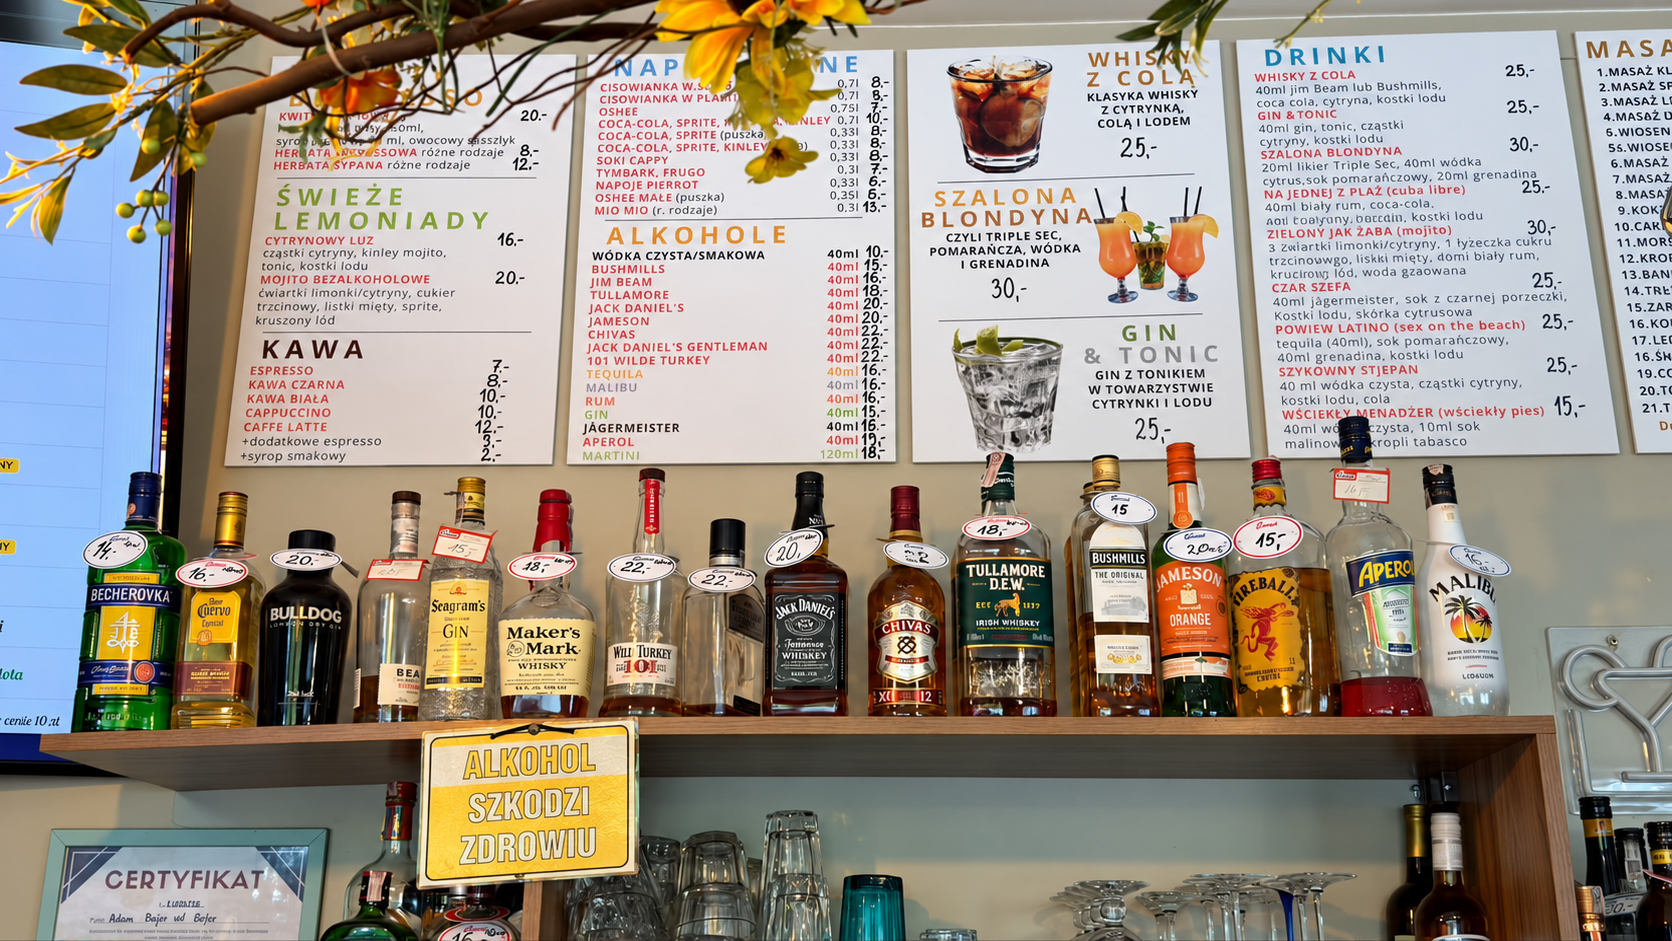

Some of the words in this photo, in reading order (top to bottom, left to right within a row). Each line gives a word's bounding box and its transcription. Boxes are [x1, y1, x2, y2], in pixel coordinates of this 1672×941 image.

[1088, 50, 1192, 68] WHISKY
[1264, 45, 1385, 67] DRINKI
[1255, 72, 1305, 83] WHISKY
[1310, 71, 1317, 81] Z
[1321, 70, 1356, 80] COLA
[1505, 64, 1535, 77] 25,-
[1597, 65, 1653, 77] 1.MASAŻ
[1087, 72, 1099, 87] Z
[1256, 85, 1286, 94] 40ml
[1290, 84, 1308, 96] jim
[1314, 82, 1349, 94] Beam
[1353, 81, 1373, 92] lub
[1377, 80, 1442, 92] Bushmills,
[1087, 91, 1145, 102] KLASYKA
[1148, 89, 1198, 100] WHISKY
[599, 107, 638, 116] OSHEE
[1101, 106, 1108, 115] Z
[1113, 103, 1184, 115] CYTRYNKĄ,
[1097, 118, 1132, 130] COLĄ
[1145, 116, 1190, 126] LODEM
[1120, 137, 1158, 159] 25,-
[1261, 148, 1322, 160] SZALONA
[1327, 146, 1402, 158] BLONDYNA
[597, 156, 625, 166] SOKI
[629, 155, 669, 165] CAPPY
[1611, 156, 1669, 168] 6.MASAŻ
[596, 169, 659, 179] TYMBARK,
[663, 168, 705, 177] FRUGO
[596, 181, 643, 191] NAPOJE
[646, 180, 698, 190] PIERROT
[277, 183, 403, 206] ŚWIEŻE
[595, 193, 635, 203] OSHEE
[639, 193, 672, 202] MAŁE
[675, 192, 725, 205] (puszka)
[935, 187, 1077, 207] SZALONA
[594, 206, 619, 215] MIO
[624, 206, 648, 215] MIO
[275, 212, 489, 230] LEMONIADY
[922, 208, 1092, 228] BLONDYNA
[265, 236, 345, 246] CYTRYNOWY
[350, 236, 374, 245] LUZ
[606, 226, 786, 245] ALKOHOLE
[946, 232, 982, 242] CZYLI
[986, 232, 1031, 241] TRIPLE
[1036, 231, 1062, 242] SEC,
[592, 250, 641, 261] WÓDKA
[646, 250, 765, 261] CZYSTA/SMAKOWA
[827, 249, 859, 259] 40ml
[930, 244, 1027, 258] POMARAŃCZA,
[1031, 242, 1081, 254] WÓDKA
[592, 264, 665, 274] BUSHMILLS
[970, 258, 1049, 269] GRENADINA
[260, 274, 309, 285] MOJITO
[313, 274, 430, 284] BEZALKOHOLOWE
[590, 277, 612, 288] JIM
[616, 277, 652, 287] BEAM
[1272, 283, 1306, 293] CZAR
[1311, 281, 1351, 292] SZEFA
[1532, 272, 1562, 290] 25,-
[311, 288, 412, 299] limonki/cytryny,
[417, 288, 455, 298] cukier
[590, 290, 669, 300] TULLAMORE
[992, 277, 1027, 302] 30,-
[588, 303, 620, 315] JACK
[625, 303, 684, 313] DANIEL'S
[588, 317, 650, 328] JAMESON
[1276, 324, 1333, 335] POWIEW
[1338, 322, 1389, 333] LATINO
[1394, 321, 1424, 334] (sex
[1429, 322, 1446, 332] on
[1450, 320, 1474, 330] the
[1479, 319, 1526, 332] beach)
[1542, 314, 1574, 332] 25,-
[588, 330, 635, 339] CHIVAS
[1122, 324, 1177, 342] GIN
[262, 340, 363, 359] KAWA
[587, 343, 619, 354] JACK
[623, 342, 683, 352] DANIEL'S
[687, 341, 768, 352] GENTLEMAN
[587, 356, 609, 366] 101
[614, 356, 656, 365] WILDE
[661, 356, 710, 365] TURKEY
[1084, 347, 1101, 364] &
[1119, 345, 1218, 364] TONIC
[250, 366, 313, 375] ESPRESSO
[587, 369, 643, 380] TEQUILA
[1095, 370, 1121, 380] GIN
[1125, 370, 1132, 380] Z
[1137, 368, 1205, 379] TONIKIEM
[1279, 365, 1356, 377] SZYKOWNY
[1361, 364, 1418, 377] STJEPAN
[248, 380, 286, 390] KAWA
[291, 380, 345, 389] CZARNA
[586, 383, 637, 393] MALIBU
[1088, 385, 1101, 395] W
[1106, 382, 1213, 394] TOWARZYSTWIE
[247, 394, 285, 404] KAWA
[290, 394, 329, 404] BIAŁA
[585, 397, 615, 406] RUM
[1092, 398, 1159, 409] CYTRYNKI
[1174, 397, 1212, 408] LODU
[245, 408, 331, 418] CAPPUCCINO
[1438, 406, 1505, 419] (wściekły
[1510, 405, 1545, 419] pies)
[1554, 396, 1586, 418] 15,-
[585, 410, 608, 420] GIN
[244, 422, 282, 432] CAFFE
[288, 422, 327, 432] LATTE
[1135, 418, 1171, 443] 25,-
[242, 436, 319, 446] +dodatkowe
[324, 437, 381, 447] espresso
[583, 437, 634, 447] APEROL
[241, 451, 282, 463] +syrop
[287, 451, 346, 463] smakowy
[582, 451, 640, 460] MARTINI
[1256, 532, 1286, 551] 15,-
[1092, 552, 1146, 564] BUSHMILLS
[966, 563, 1045, 578] TULLAMORE
[1358, 560, 1414, 588] APEROL
[989, 578, 1025, 591] D.E.W.
[1156, 567, 1222, 593] JAMESON
[91, 588, 170, 603] BECHEROVKA
[197, 604, 231, 618] Cuervo
[431, 599, 486, 614] Seagram's
[776, 601, 798, 620] JACK
[799, 598, 835, 620] DANIEL'S
[270, 606, 342, 624] BULLDOG
[1170, 613, 1211, 627] ORANGE
[882, 620, 931, 634] CHIVAS
[1002, 619, 1040, 627] WHISKEY
[443, 624, 469, 639] GIN
[507, 626, 580, 639] Maker's
[636, 645, 671, 660] TURKEY
[782, 652, 827, 660] WHISKEY
[518, 662, 566, 670] WHISKY
[624, 659, 657, 673] 101
[921, 690, 932, 702] 12
[463, 743, 596, 780] ALKOHOL
[468, 786, 590, 823] SZKODZI
[459, 827, 596, 865] ZDROWIU
[105, 870, 264, 890] CERTYFIKAT
[109, 914, 134, 923] Adam
